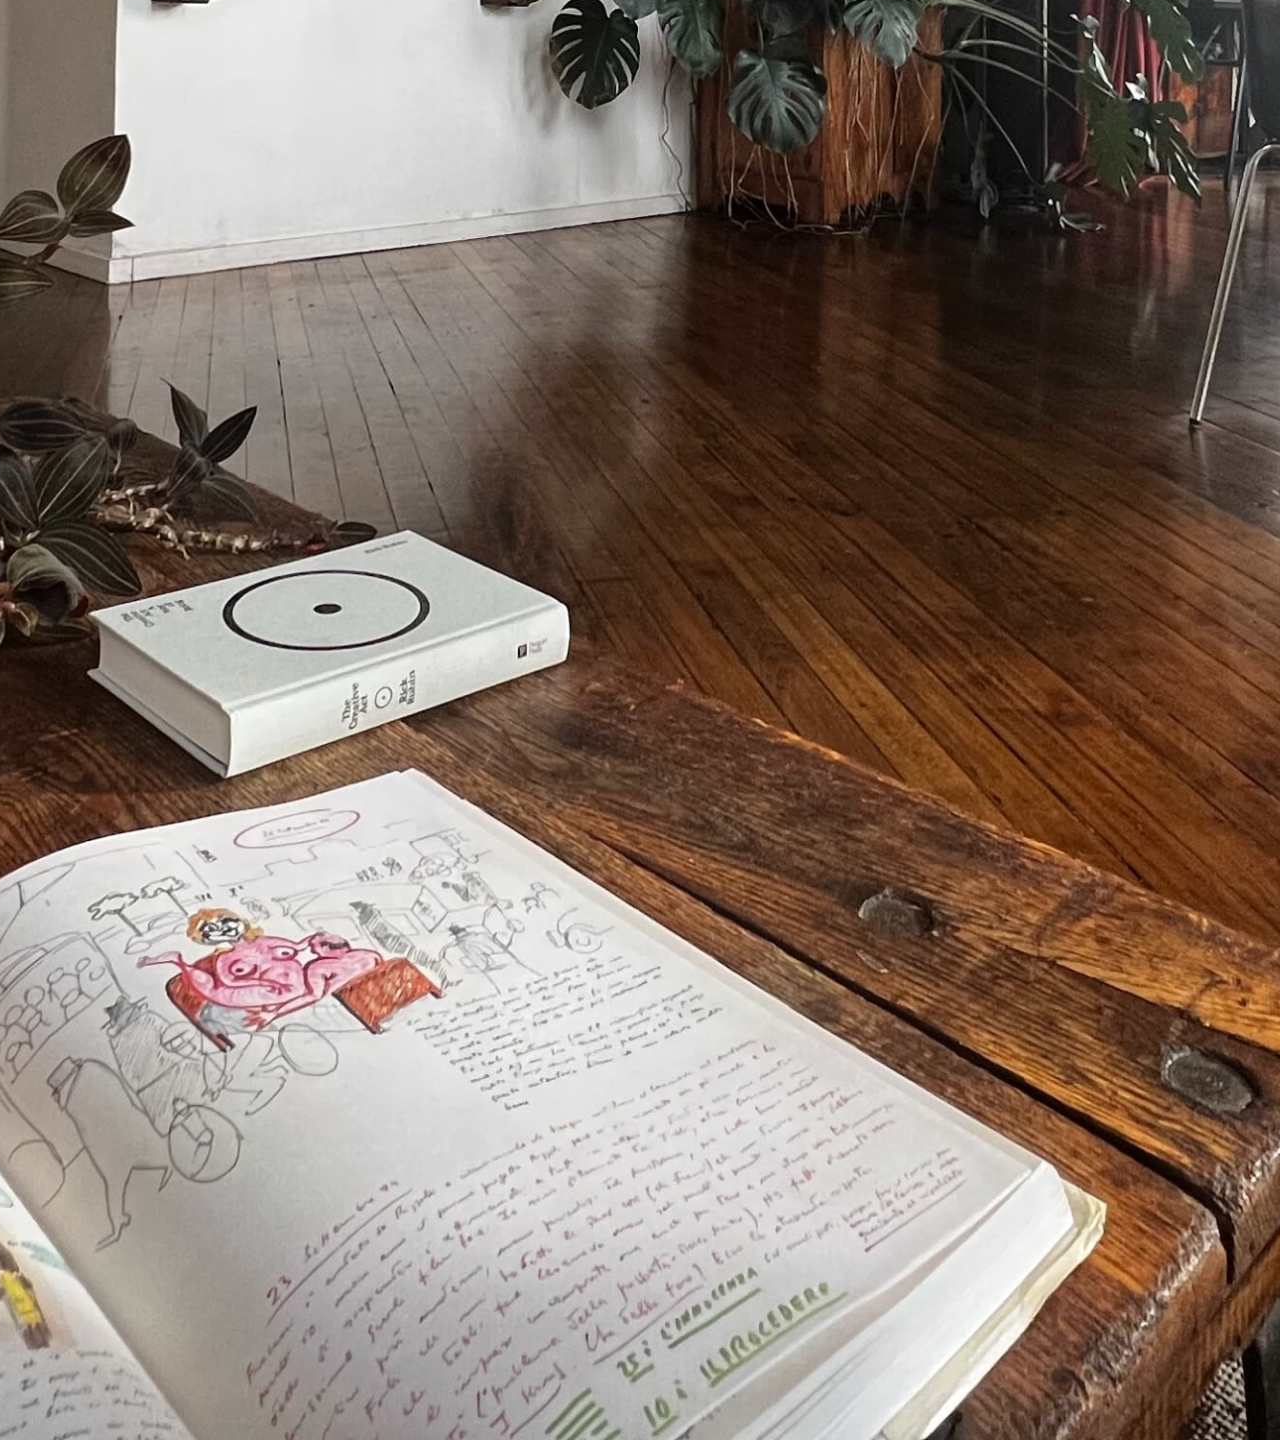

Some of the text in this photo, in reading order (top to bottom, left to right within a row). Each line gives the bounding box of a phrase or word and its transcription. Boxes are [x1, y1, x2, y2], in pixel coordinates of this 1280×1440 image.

[359, 694, 368, 714] Act
[398, 678, 408, 705] Rick
[341, 699, 352, 722] The
[348, 682, 360, 730] Creative
